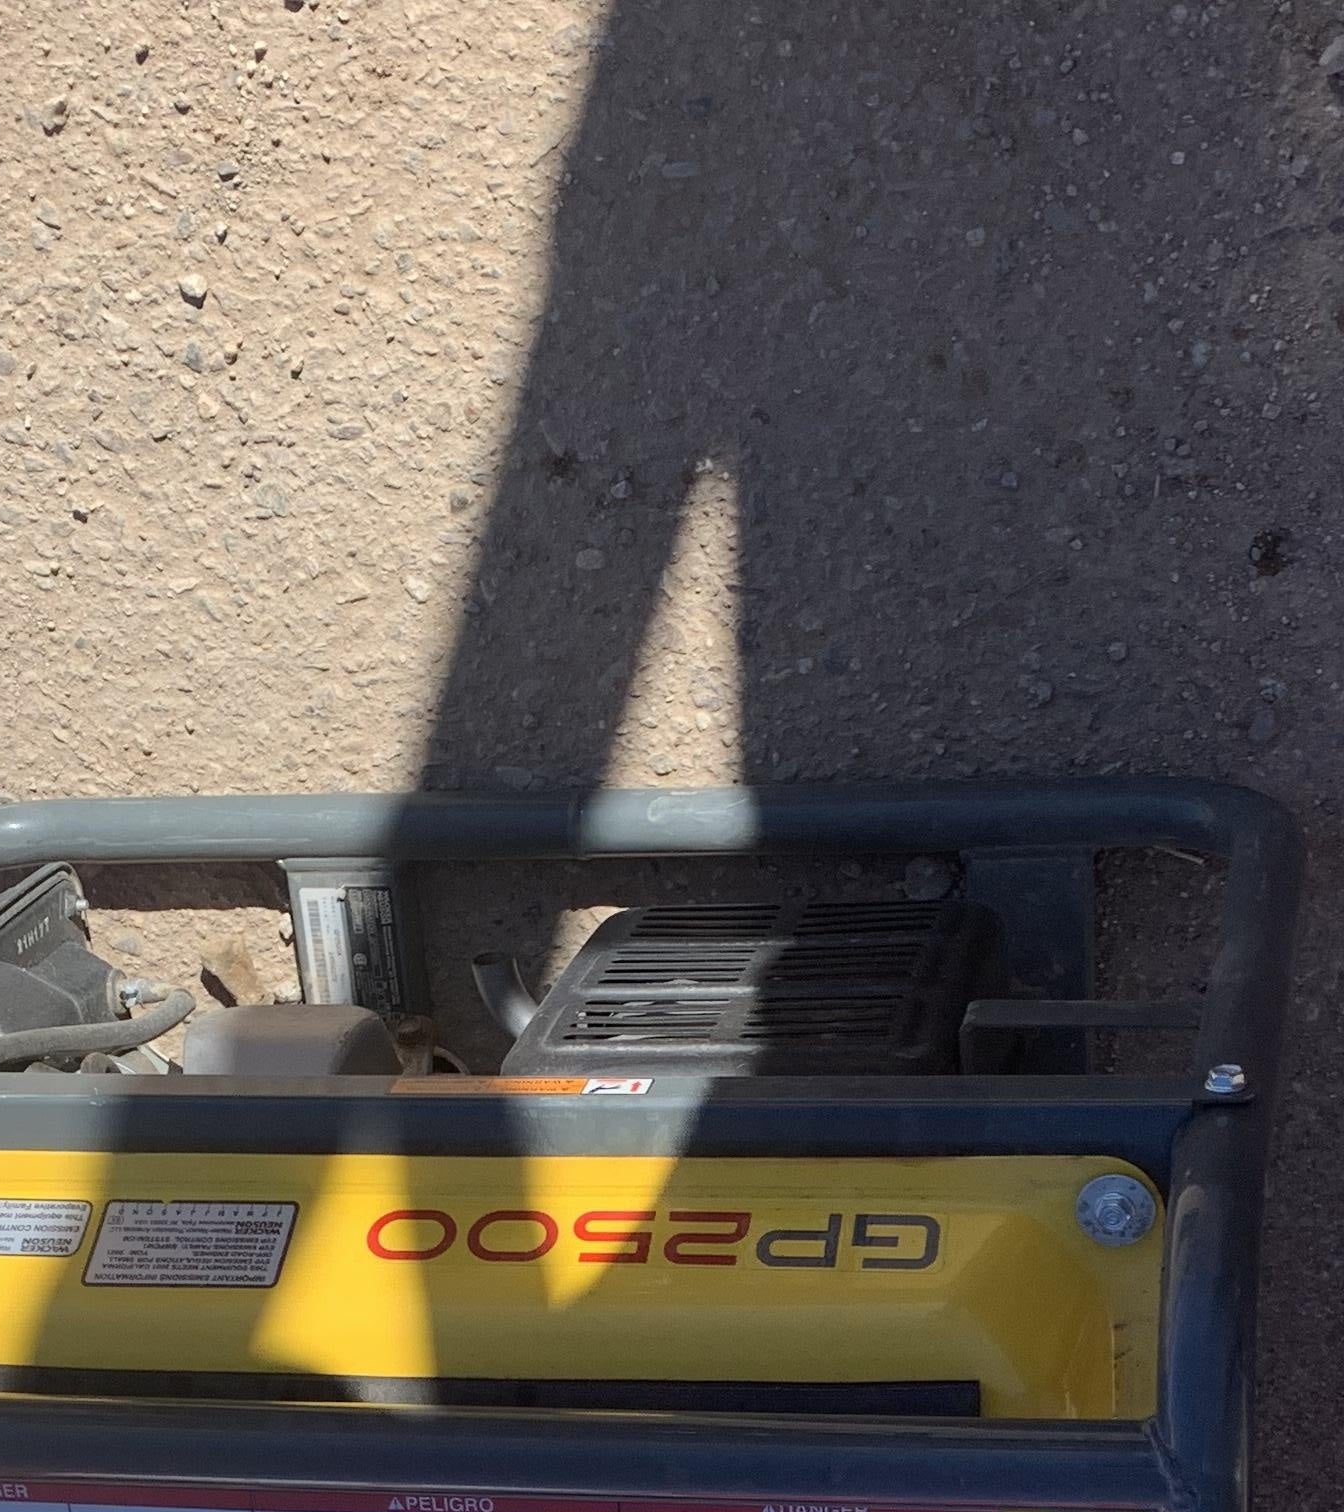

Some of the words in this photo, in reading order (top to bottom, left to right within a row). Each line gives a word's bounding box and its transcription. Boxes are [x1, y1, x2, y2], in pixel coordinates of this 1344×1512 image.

[14, 1211, 62, 1220] equipment
[22, 1238, 72, 1246] NEUSON
[367, 1208, 940, 1270] GP2500
[20, 1245, 68, 1253] WACKER
[407, 1496, 494, 1512] PELIGRO
